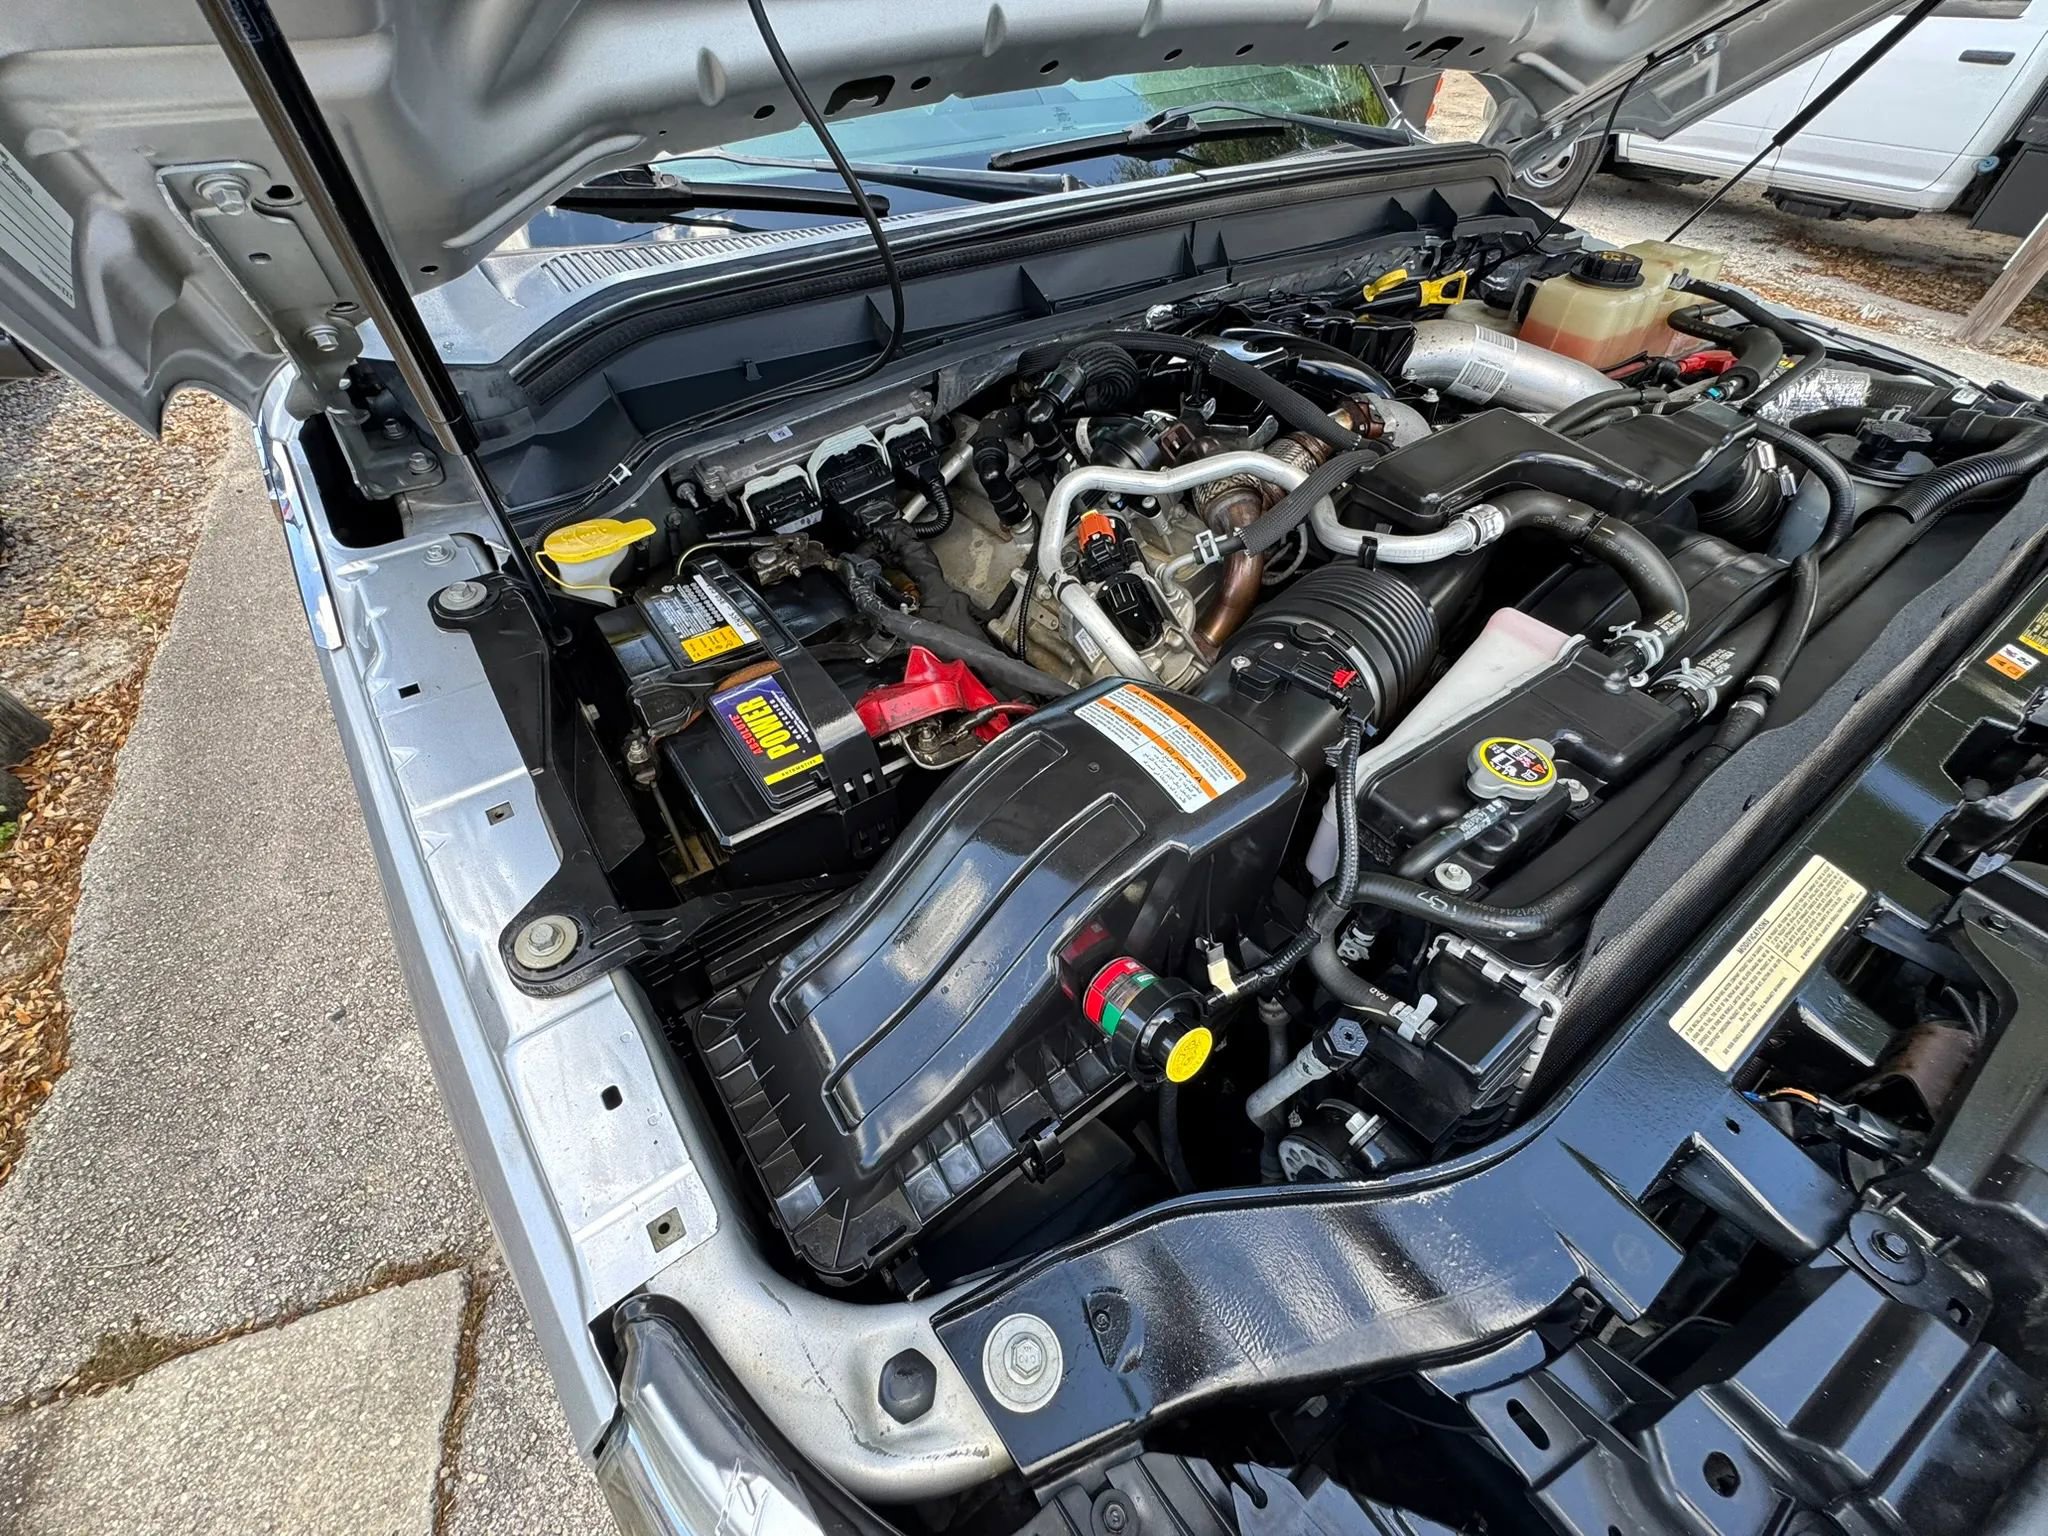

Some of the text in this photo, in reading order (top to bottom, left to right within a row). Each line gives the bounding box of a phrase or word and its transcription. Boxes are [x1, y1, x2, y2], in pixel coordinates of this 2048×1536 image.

[729, 715, 763, 755] ABSOLUTE
[736, 695, 799, 761] POWER
[769, 699, 802, 740] BATTERIES
[1193, 730, 1233, 768] AVERTISSEMENT
[1736, 917, 1770, 955] MODIFICATIONS
[1368, 985, 1390, 1002] RAD
